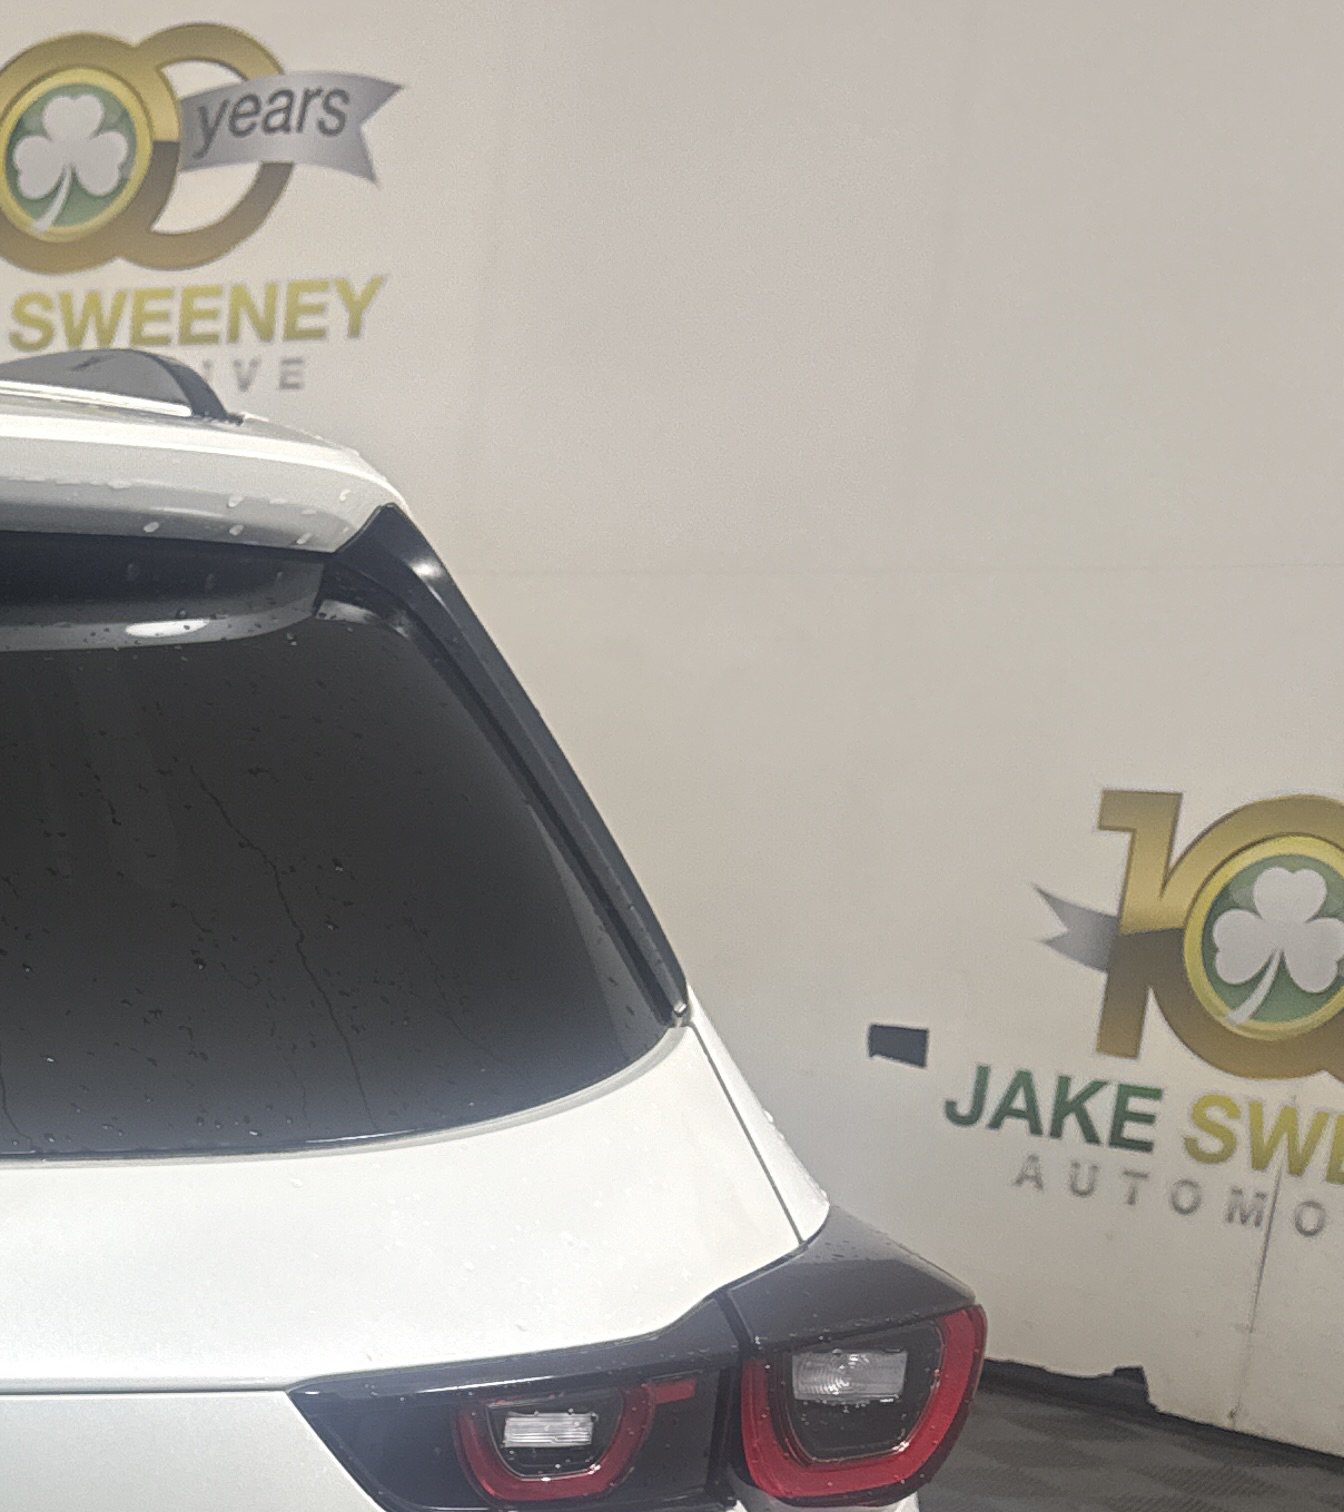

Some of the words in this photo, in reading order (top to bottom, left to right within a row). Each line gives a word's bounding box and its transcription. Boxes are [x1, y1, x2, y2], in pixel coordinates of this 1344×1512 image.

[191, 84, 350, 161] years
[11, 275, 390, 353] SWEENEY
[944, 1063, 1164, 1153] JAKE
